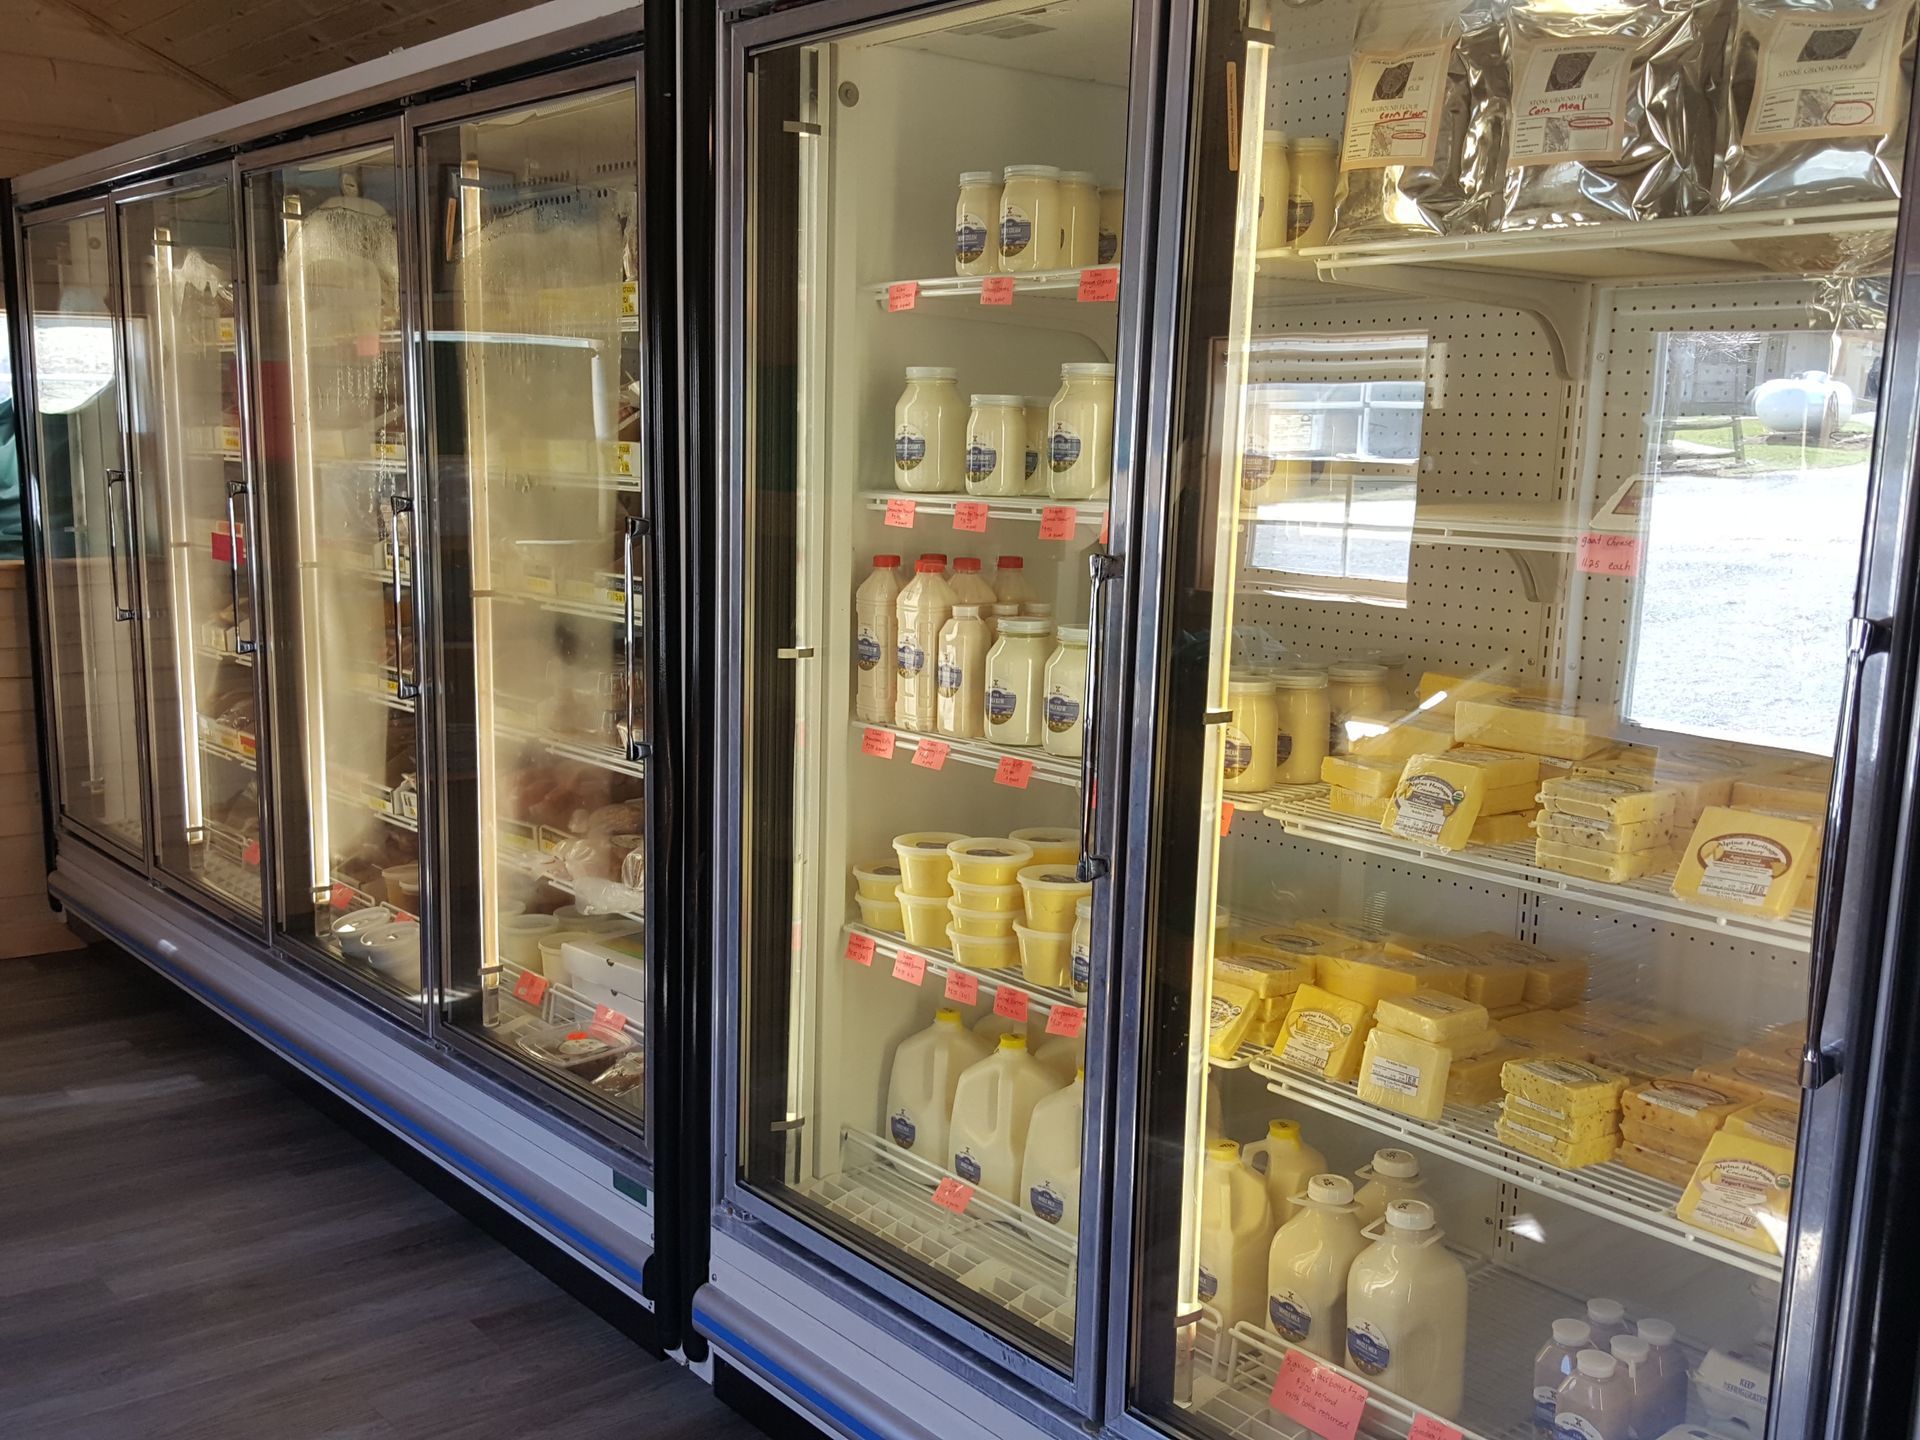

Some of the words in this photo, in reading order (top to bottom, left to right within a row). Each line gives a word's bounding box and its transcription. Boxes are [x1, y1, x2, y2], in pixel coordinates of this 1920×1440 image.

[1528, 105, 1550, 116] Corn
[1558, 97, 1586, 112] Meal
[1608, 560, 1631, 571] each
[1716, 838, 1744, 848] Alpine
[1746, 839, 1779, 857] Heritage
[1729, 845, 1765, 855] Creamery
[1726, 1169, 1759, 1180] Creamery
[1741, 1164, 1773, 1183] Heritage
[1739, 1377, 1756, 1390] KEEP
